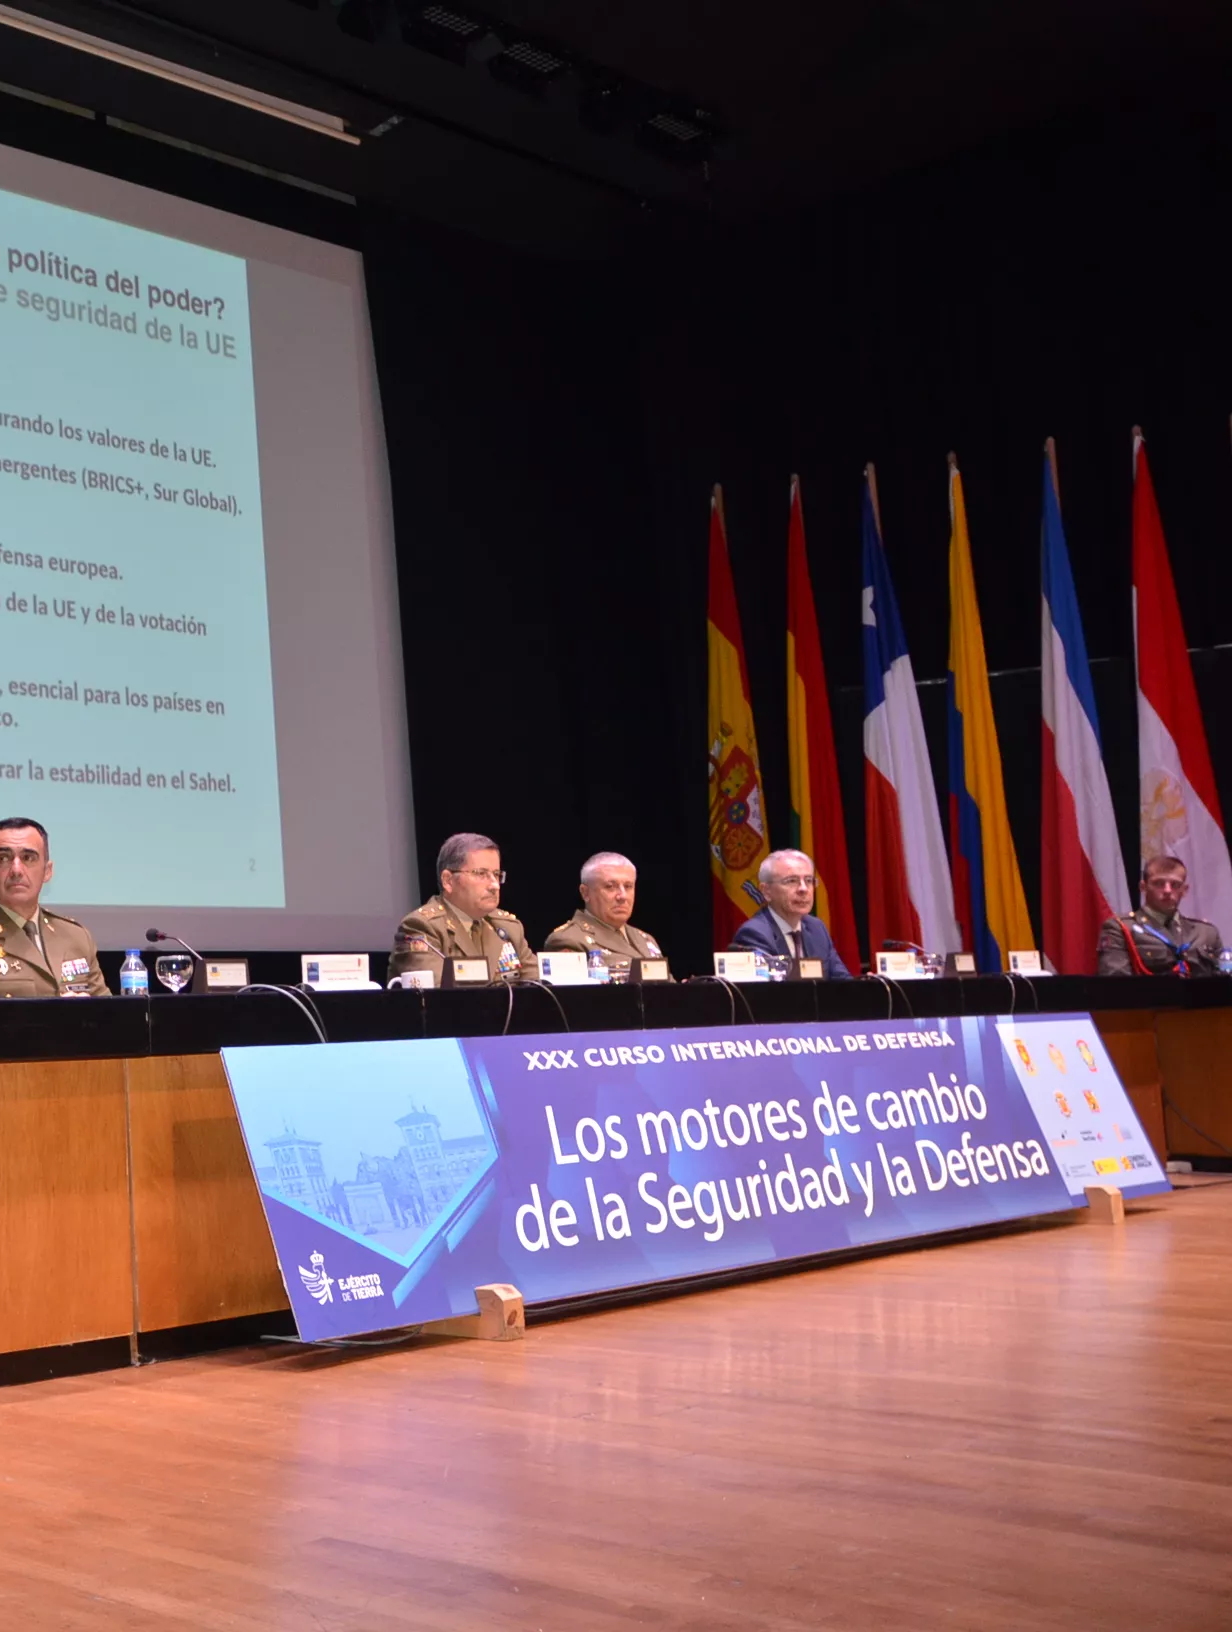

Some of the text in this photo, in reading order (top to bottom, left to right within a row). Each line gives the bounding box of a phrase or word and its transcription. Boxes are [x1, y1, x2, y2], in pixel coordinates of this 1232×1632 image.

[7, 247, 98, 288] política
[104, 269, 140, 299] del
[147, 283, 225, 321] poder?
[16, 288, 138, 335] seguridad
[144, 316, 173, 344] de
[179, 323, 199, 350] la
[205, 329, 237, 360] UE
[58, 418, 83, 442] los
[86, 427, 146, 454] valores
[149, 438, 169, 459] de
[172, 441, 188, 463] la
[190, 447, 217, 469] UE.
[153, 482, 179, 504] Sur
[182, 488, 243, 517] Global).
[47, 556, 124, 581] europea.
[5, 591, 28, 614] de
[32, 593, 48, 616] la
[52, 598, 77, 620] UE
[80, 606, 91, 625] y
[94, 603, 116, 625] de
[120, 605, 135, 627] la
[139, 613, 207, 637] votación
[7, 679, 79, 701] esencial
[83, 688, 121, 707] para
[125, 686, 149, 708] los
[152, 691, 203, 714] países
[205, 700, 225, 716] en
[28, 758, 45, 781] la
[48, 763, 142, 788] estabilidad
[145, 773, 167, 789] en
[170, 769, 185, 790] el
[189, 771, 236, 793] Sahel.
[248, 858, 257, 872] 2
[523, 1030, 956, 1071] XXX CURSO INTERNACIONAL DE DEFENSA
[544, 1072, 988, 1165] Los motores de cambio
[515, 1132, 1050, 1252] de la Seguridad y la Defensa
[338, 1274, 381, 1291] EJÉRCITO
[342, 1284, 384, 1302] DE TIERRA
